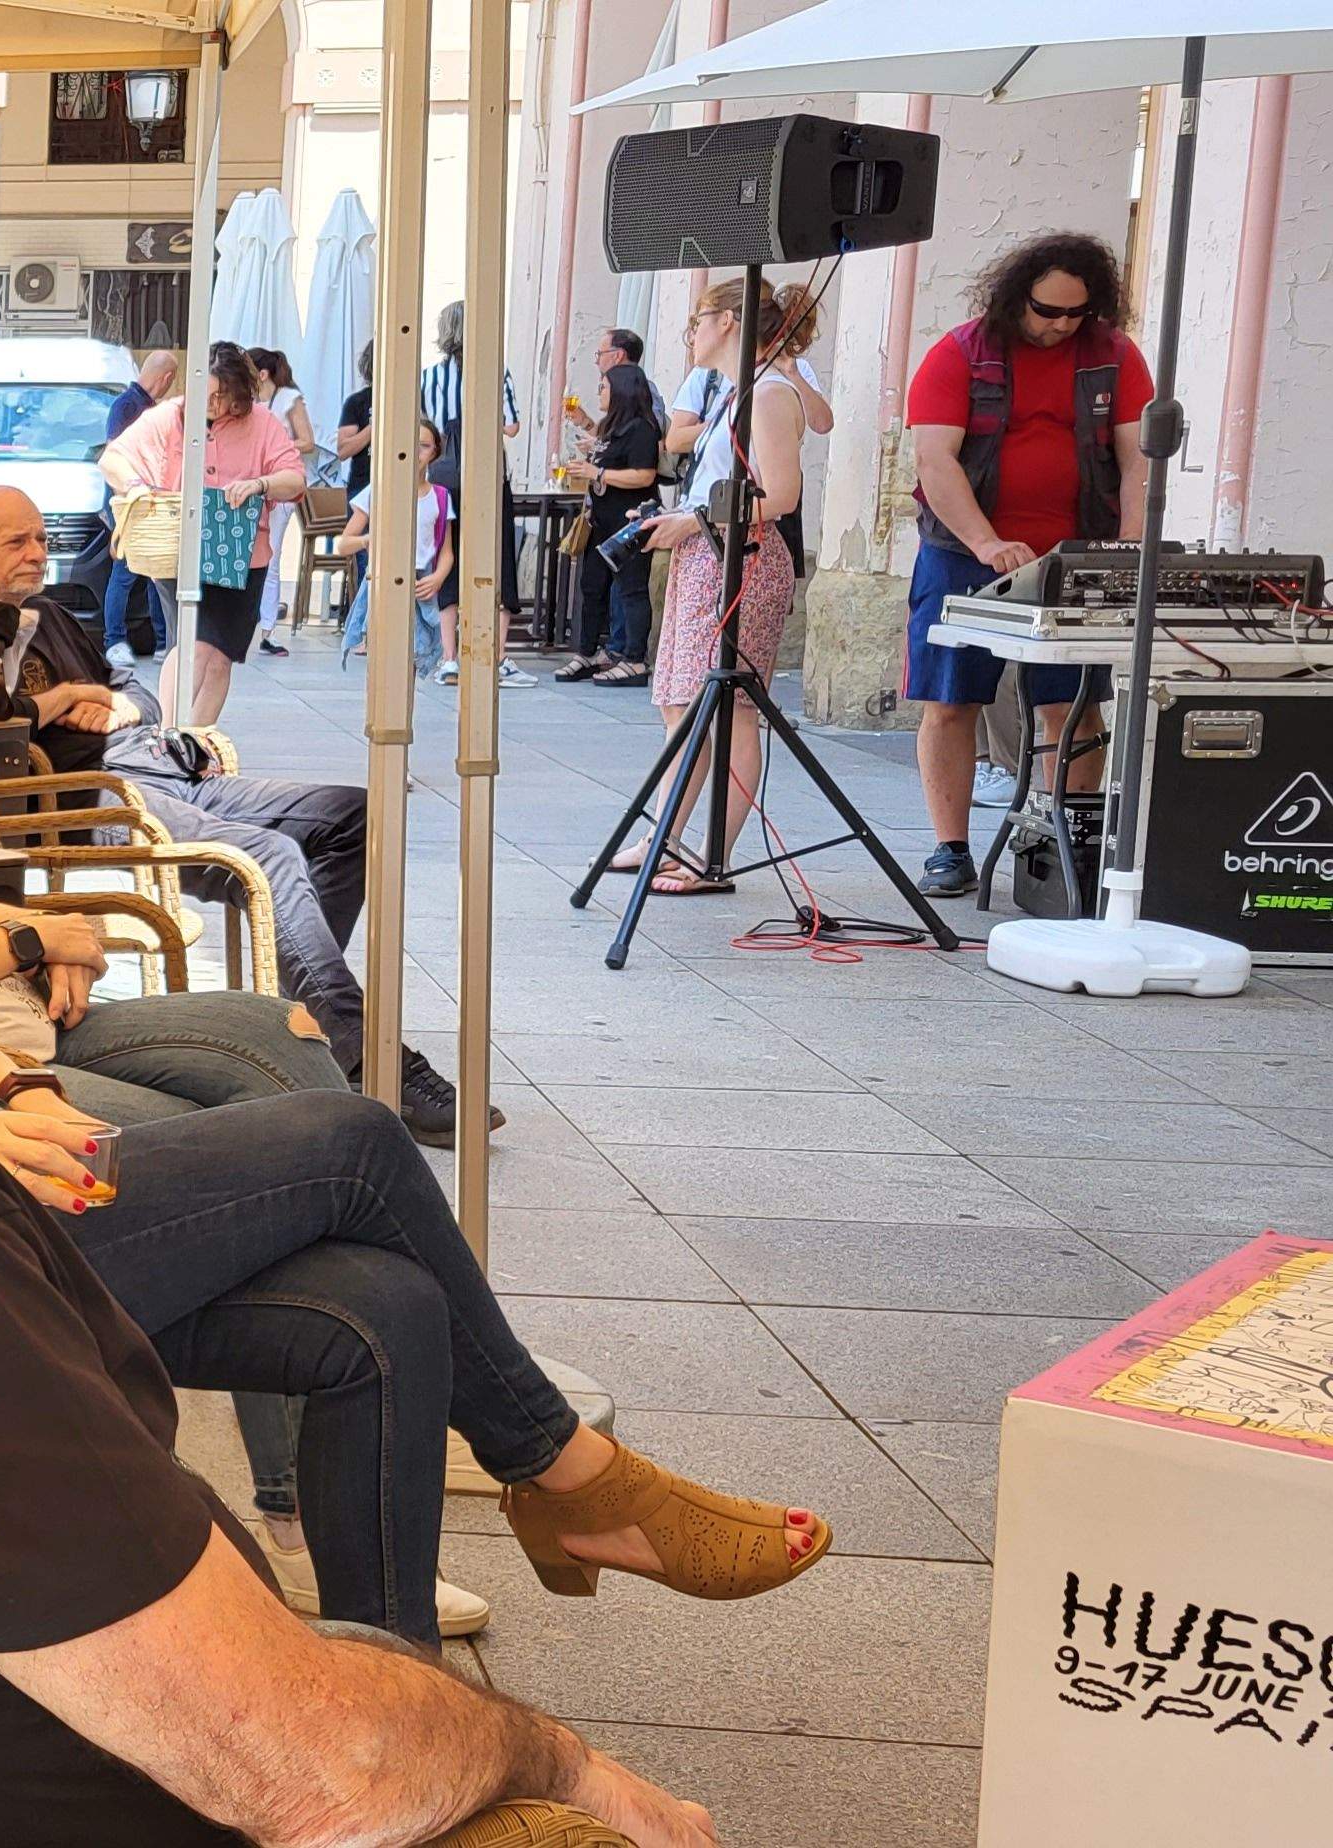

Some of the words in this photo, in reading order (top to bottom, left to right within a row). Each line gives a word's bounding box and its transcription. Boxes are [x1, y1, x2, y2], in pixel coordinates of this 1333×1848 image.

[1224, 850, 1333, 881] behring
[1254, 895, 1333, 910] SHURE
[1062, 1571, 1333, 1692] HUES
[1180, 1673, 1304, 1712] JUNE
[1058, 1677, 1333, 1752] SPAI
